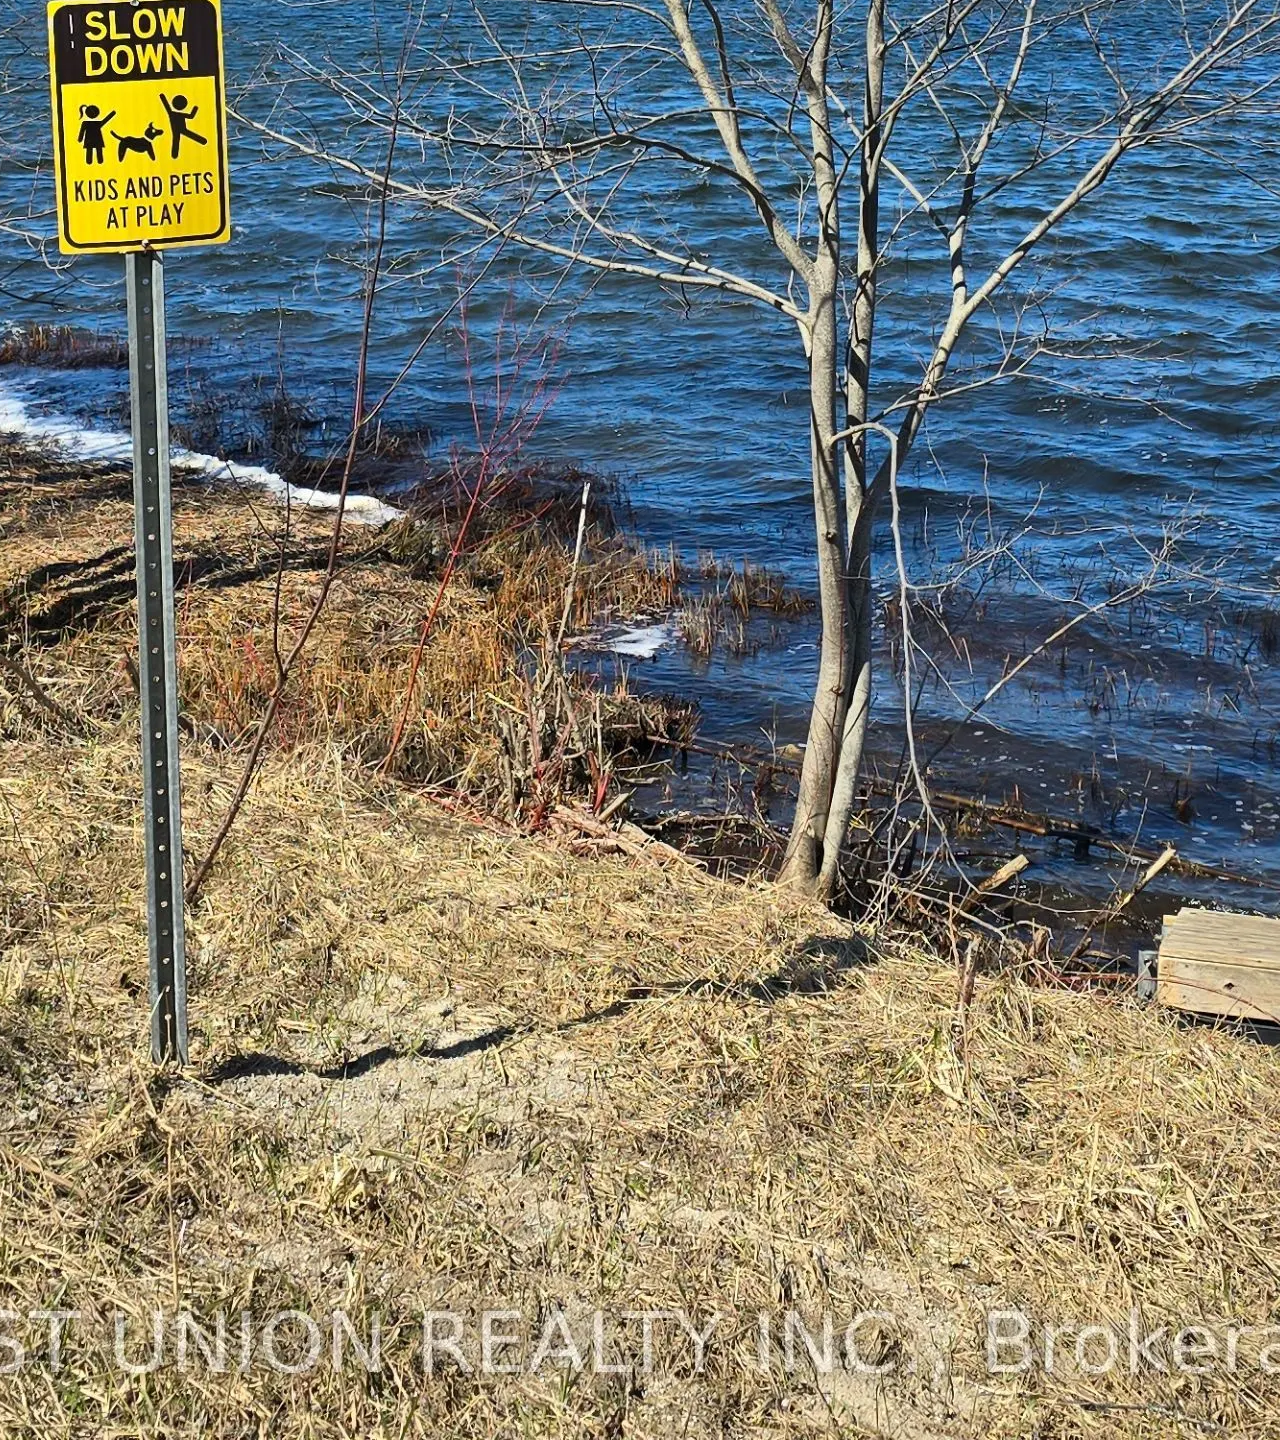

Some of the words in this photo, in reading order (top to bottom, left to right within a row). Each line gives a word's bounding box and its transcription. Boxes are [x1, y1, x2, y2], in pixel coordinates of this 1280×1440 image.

[85, 7, 186, 41] SLOW
[85, 41, 189, 77] DOWN
[74, 178, 118, 202] KIDS
[125, 176, 163, 199] AND
[170, 171, 213, 195] PETS
[107, 206, 129, 229] AT
[136, 202, 184, 227] PLAY
